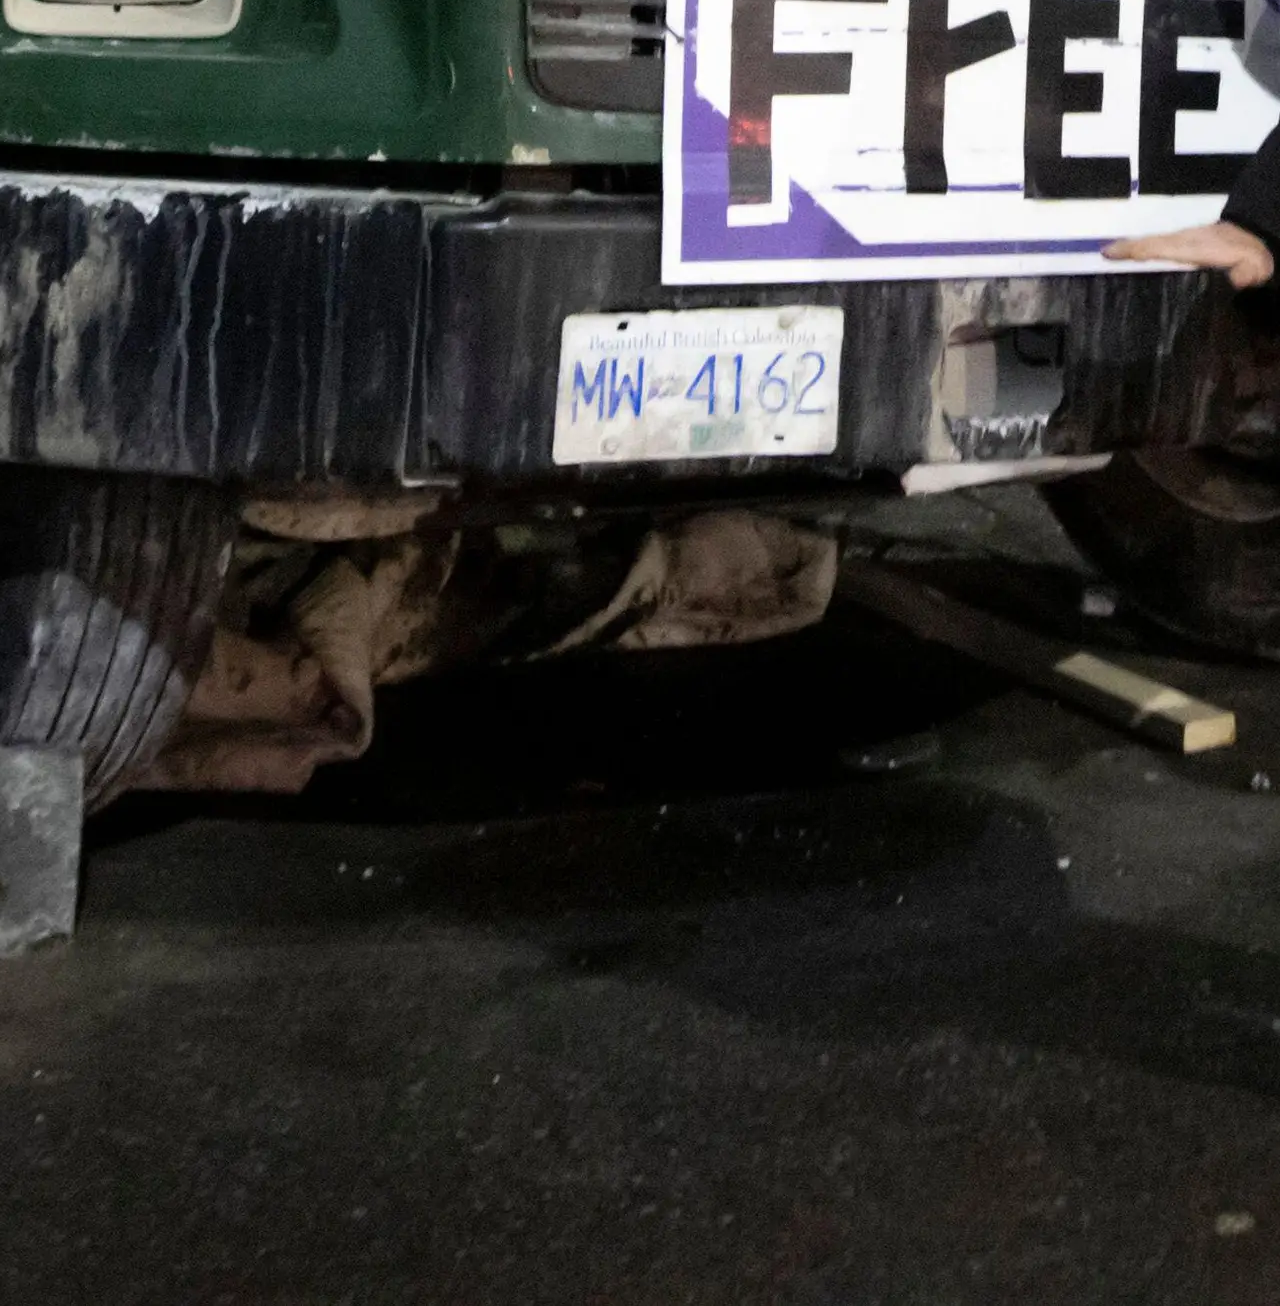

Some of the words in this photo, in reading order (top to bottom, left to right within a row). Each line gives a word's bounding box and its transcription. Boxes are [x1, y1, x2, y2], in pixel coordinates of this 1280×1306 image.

[589, 329, 668, 351] Beautiful
[672, 327, 728, 349] British
[571, 356, 645, 425] MW
[684, 350, 827, 416] 4162
